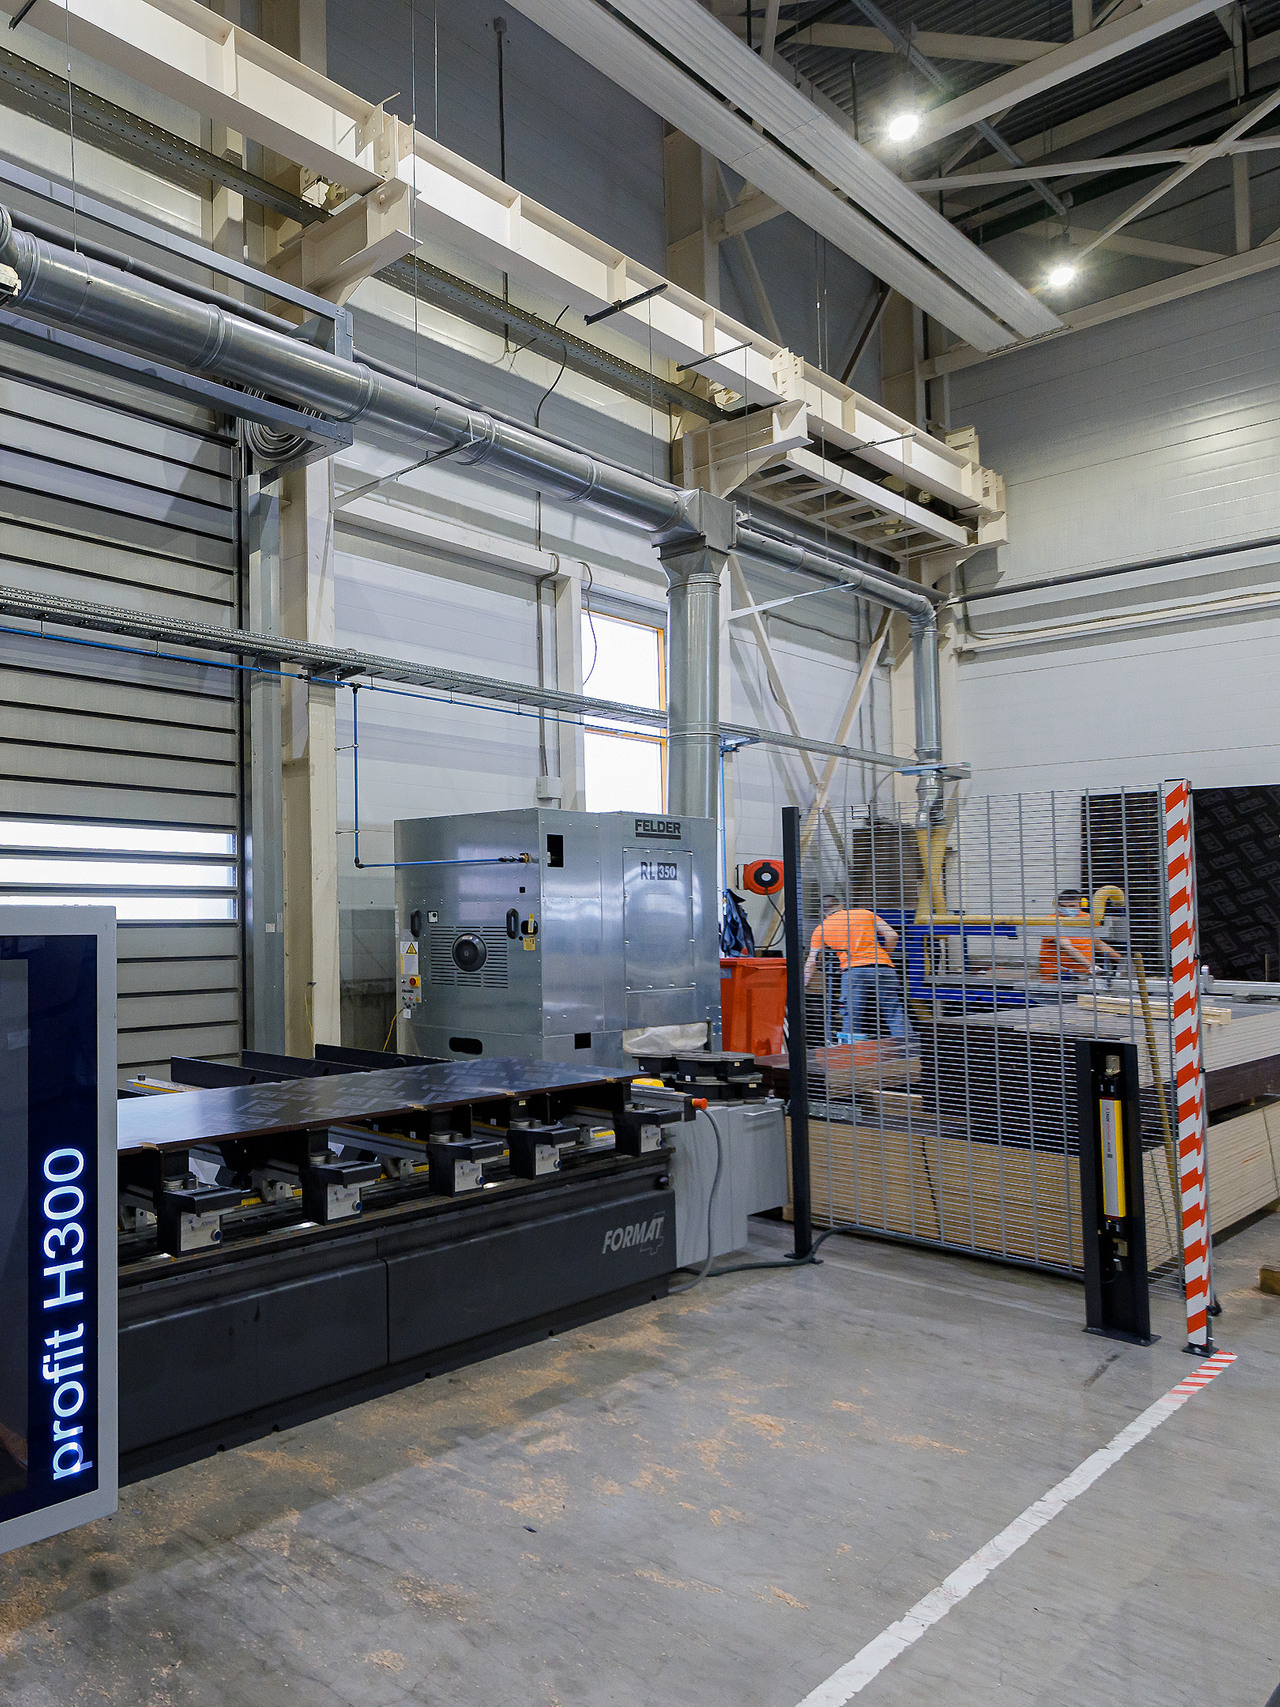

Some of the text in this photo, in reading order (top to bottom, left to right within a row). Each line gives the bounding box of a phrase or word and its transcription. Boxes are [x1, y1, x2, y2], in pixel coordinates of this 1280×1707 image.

[635, 819, 681, 834] FELDER
[641, 862, 676, 880] RL 350
[42, 1147, 94, 1480] profit H300
